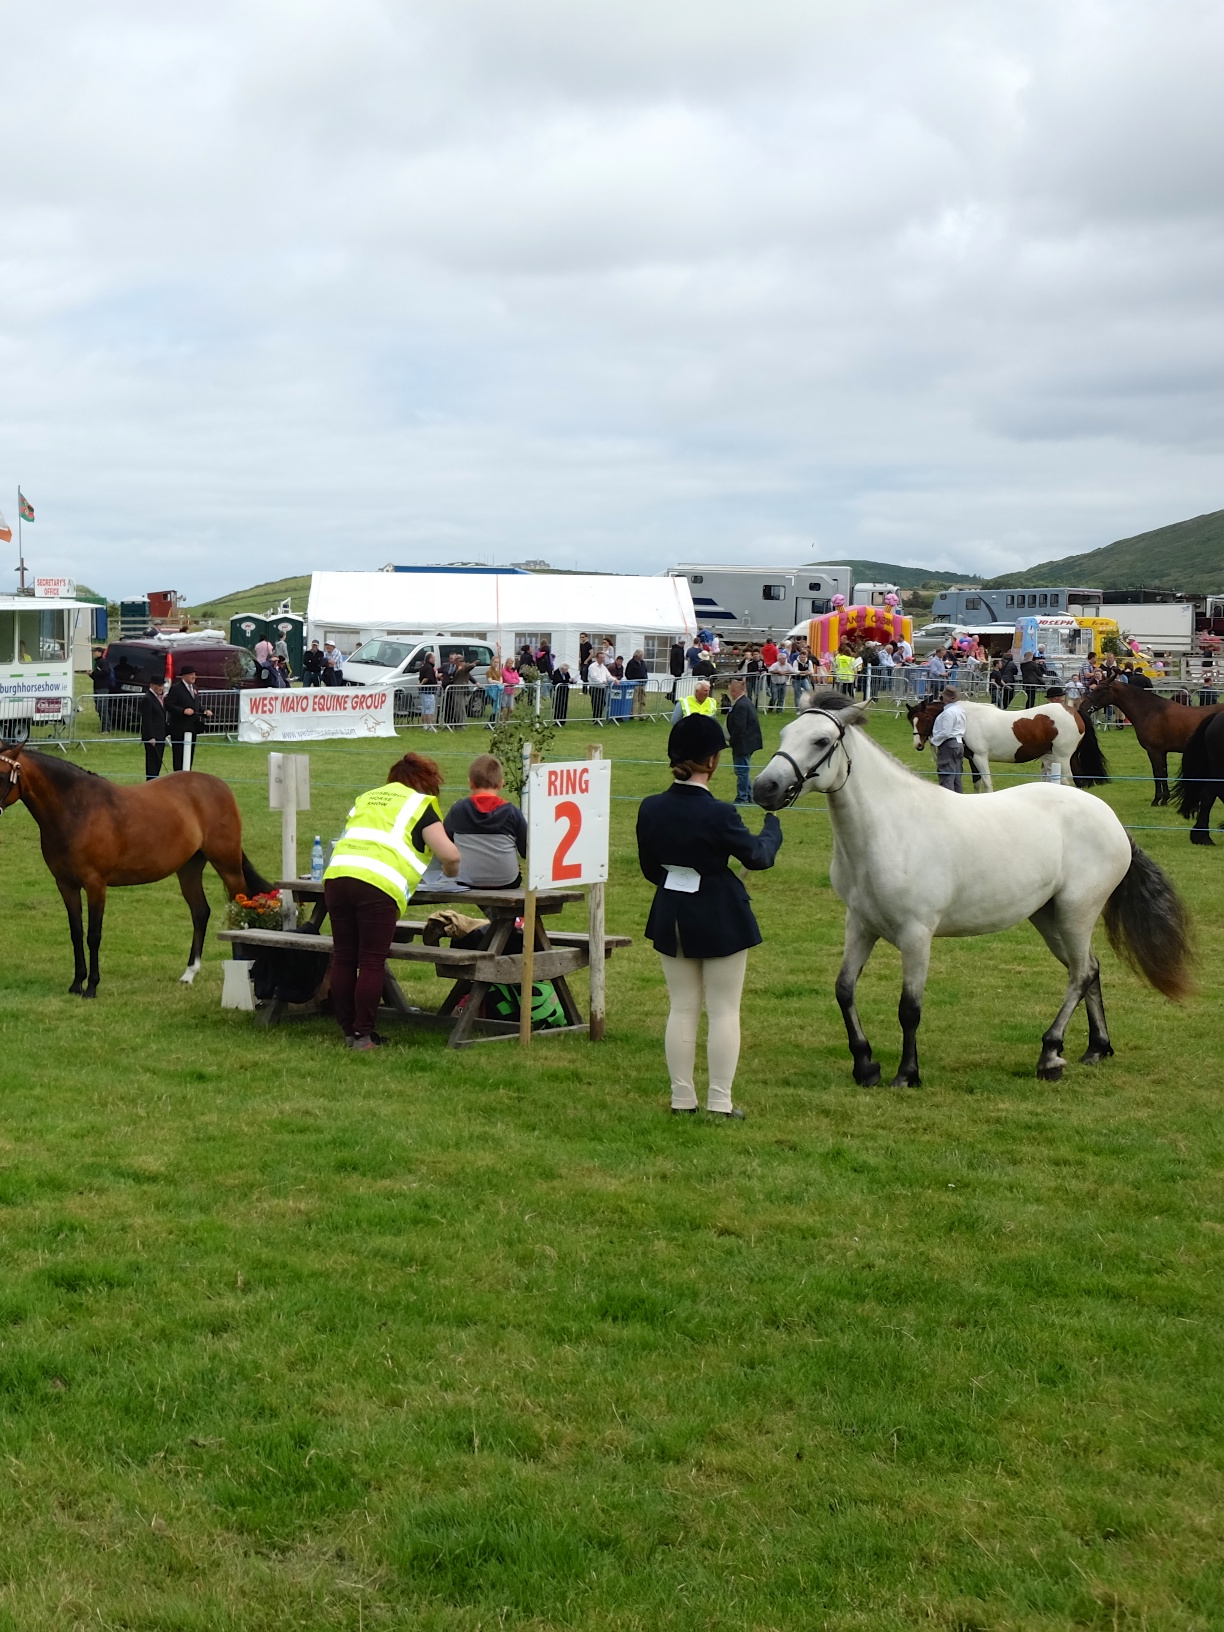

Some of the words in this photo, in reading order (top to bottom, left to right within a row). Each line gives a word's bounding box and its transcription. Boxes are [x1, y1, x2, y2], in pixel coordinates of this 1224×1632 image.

[37, 578, 66, 587] SECRETARY'S
[839, 614, 868, 626] CANDY
[249, 696, 279, 715] WEST
[280, 695, 309, 713] MAYO
[312, 694, 348, 712] EQUINE
[351, 693, 387, 711] GROUP
[548, 767, 590, 797] RING
[552, 801, 583, 882] 2
